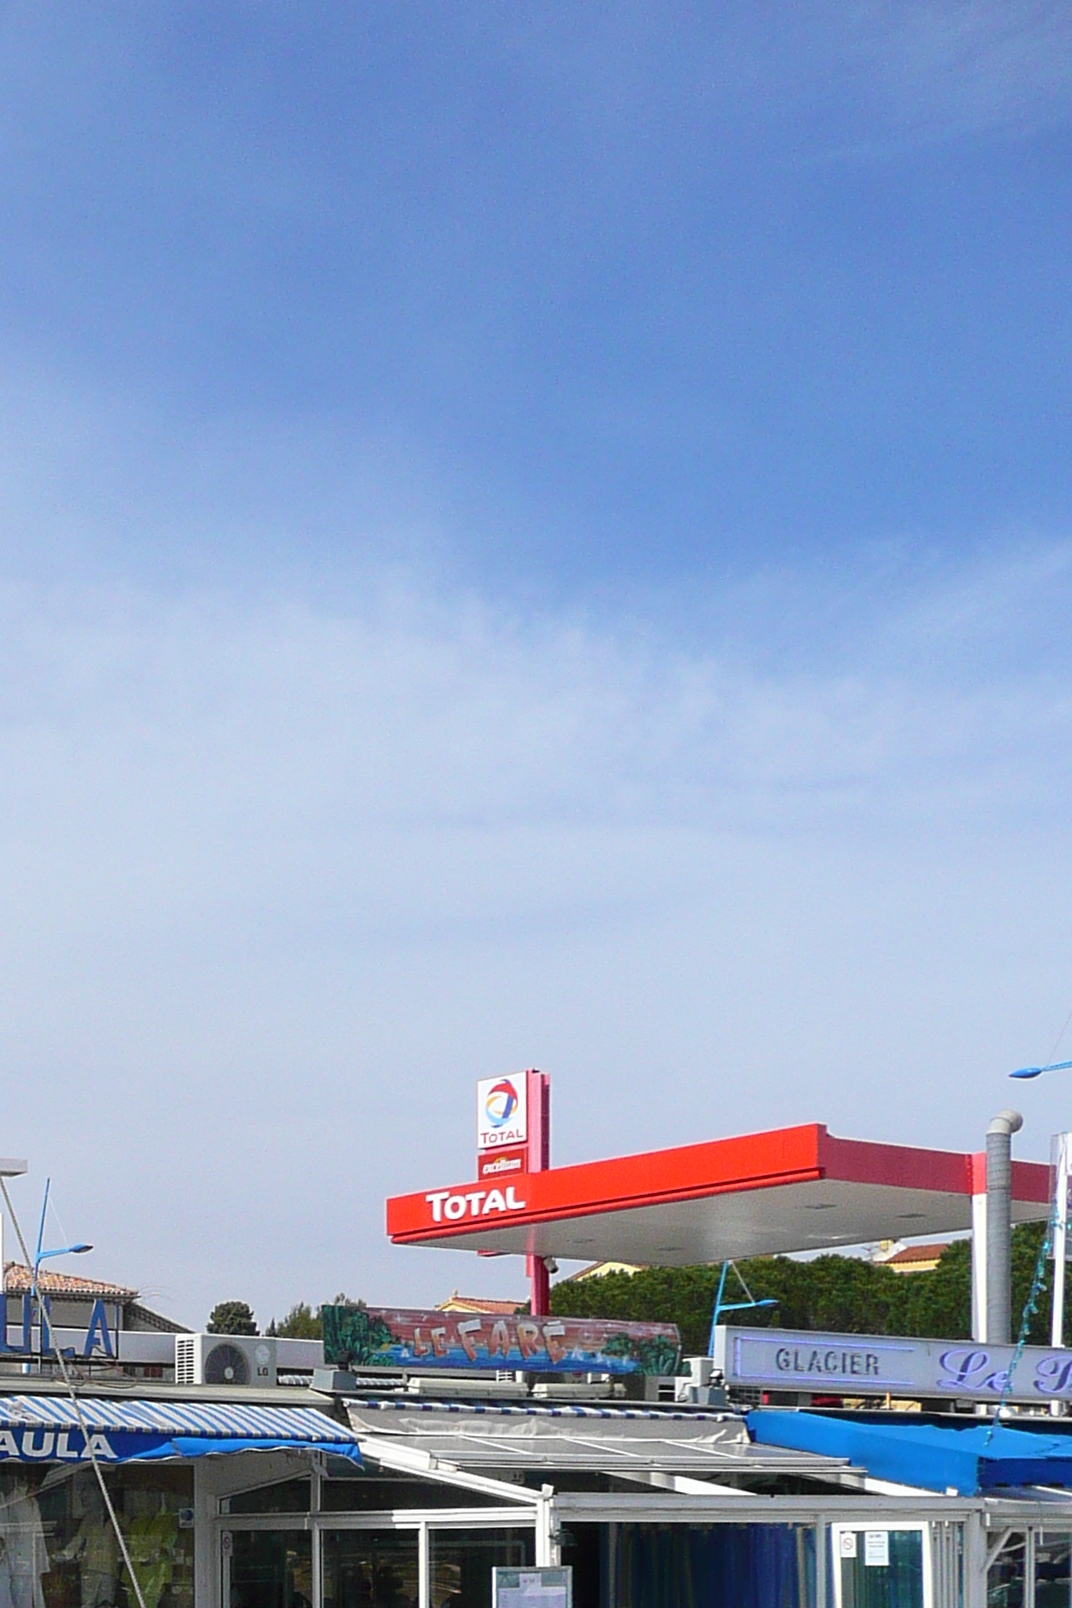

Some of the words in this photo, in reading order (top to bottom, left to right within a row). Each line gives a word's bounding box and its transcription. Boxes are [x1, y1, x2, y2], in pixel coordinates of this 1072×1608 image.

[480, 1129, 524, 1144] TOTAL
[426, 1186, 526, 1222] TOTAL
[413, 1326, 449, 1357] LE
[257, 1366, 269, 1377] LG
[776, 1347, 880, 1376] GLACIER
[936, 1349, 1010, 1393] Le
